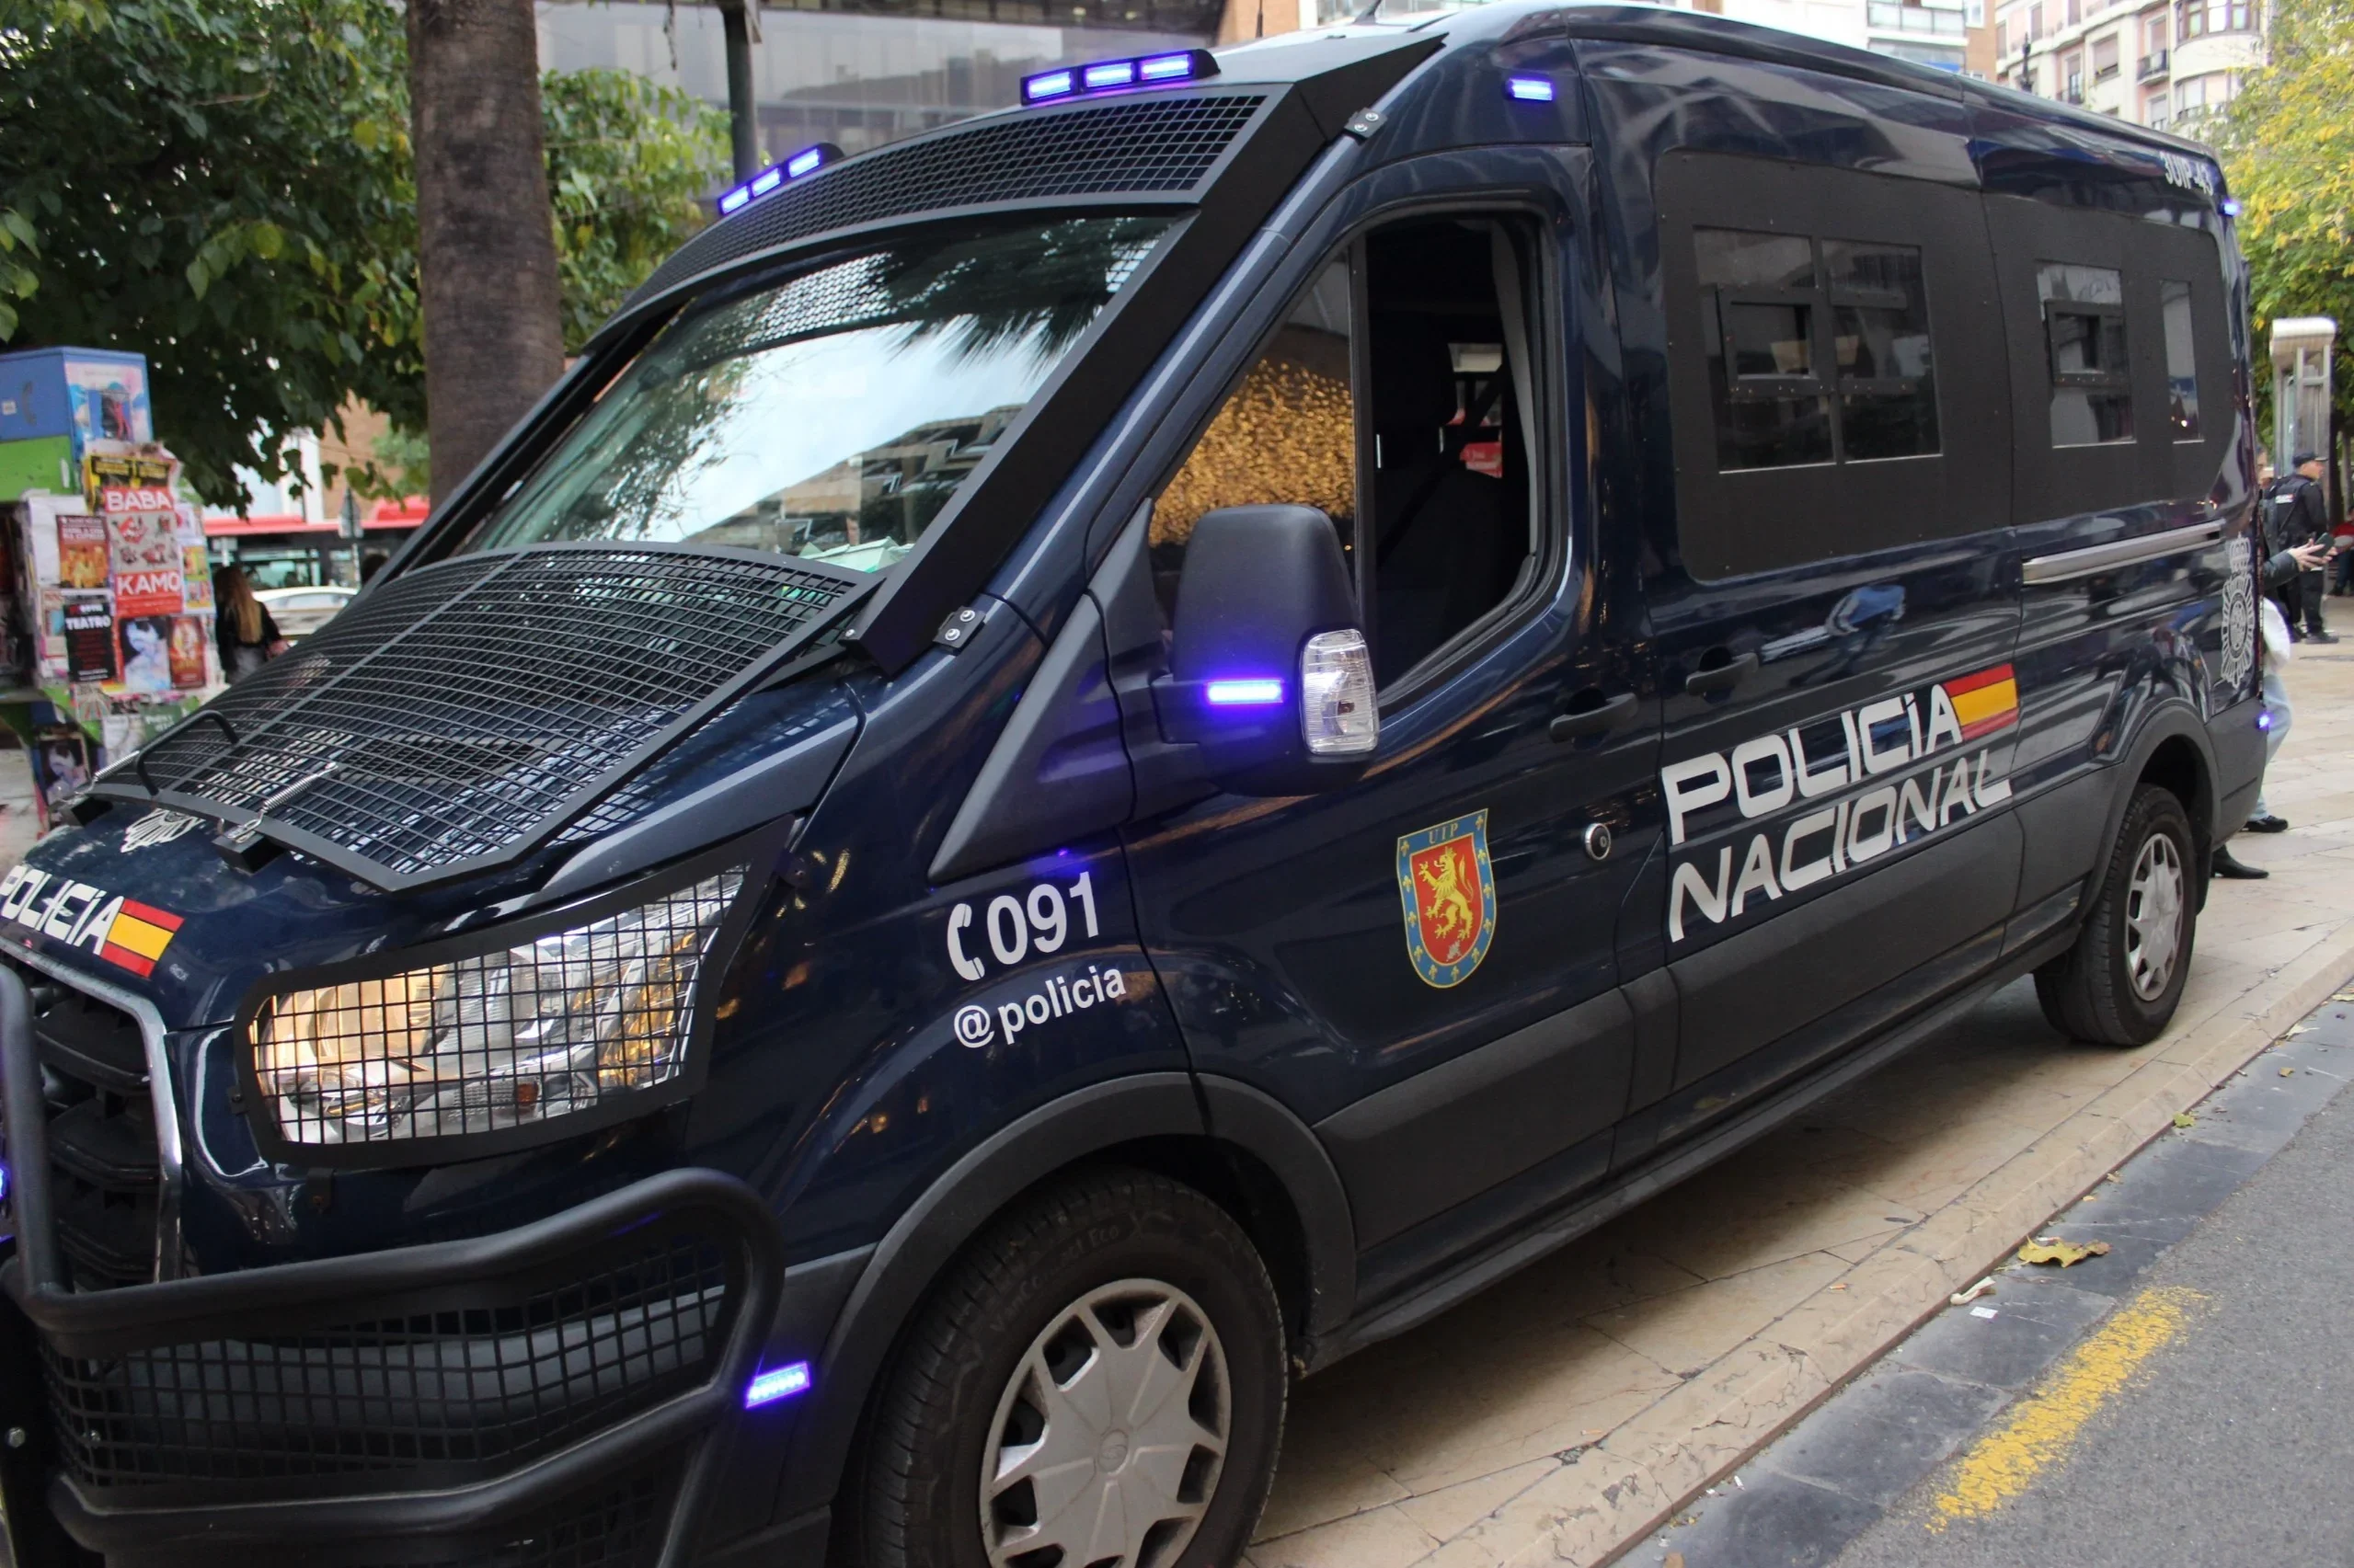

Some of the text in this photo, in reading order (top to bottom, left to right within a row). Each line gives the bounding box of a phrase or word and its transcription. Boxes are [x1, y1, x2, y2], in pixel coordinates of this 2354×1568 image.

[106, 490, 172, 511] BABA
[117, 571, 181, 596] KAMO
[66, 614, 111, 630] TEATRO
[1429, 821, 1459, 844] UIP
[1669, 749, 2013, 944] NACIONAL
[986, 870, 1099, 966] 091
[953, 965, 1128, 1049] @policia
